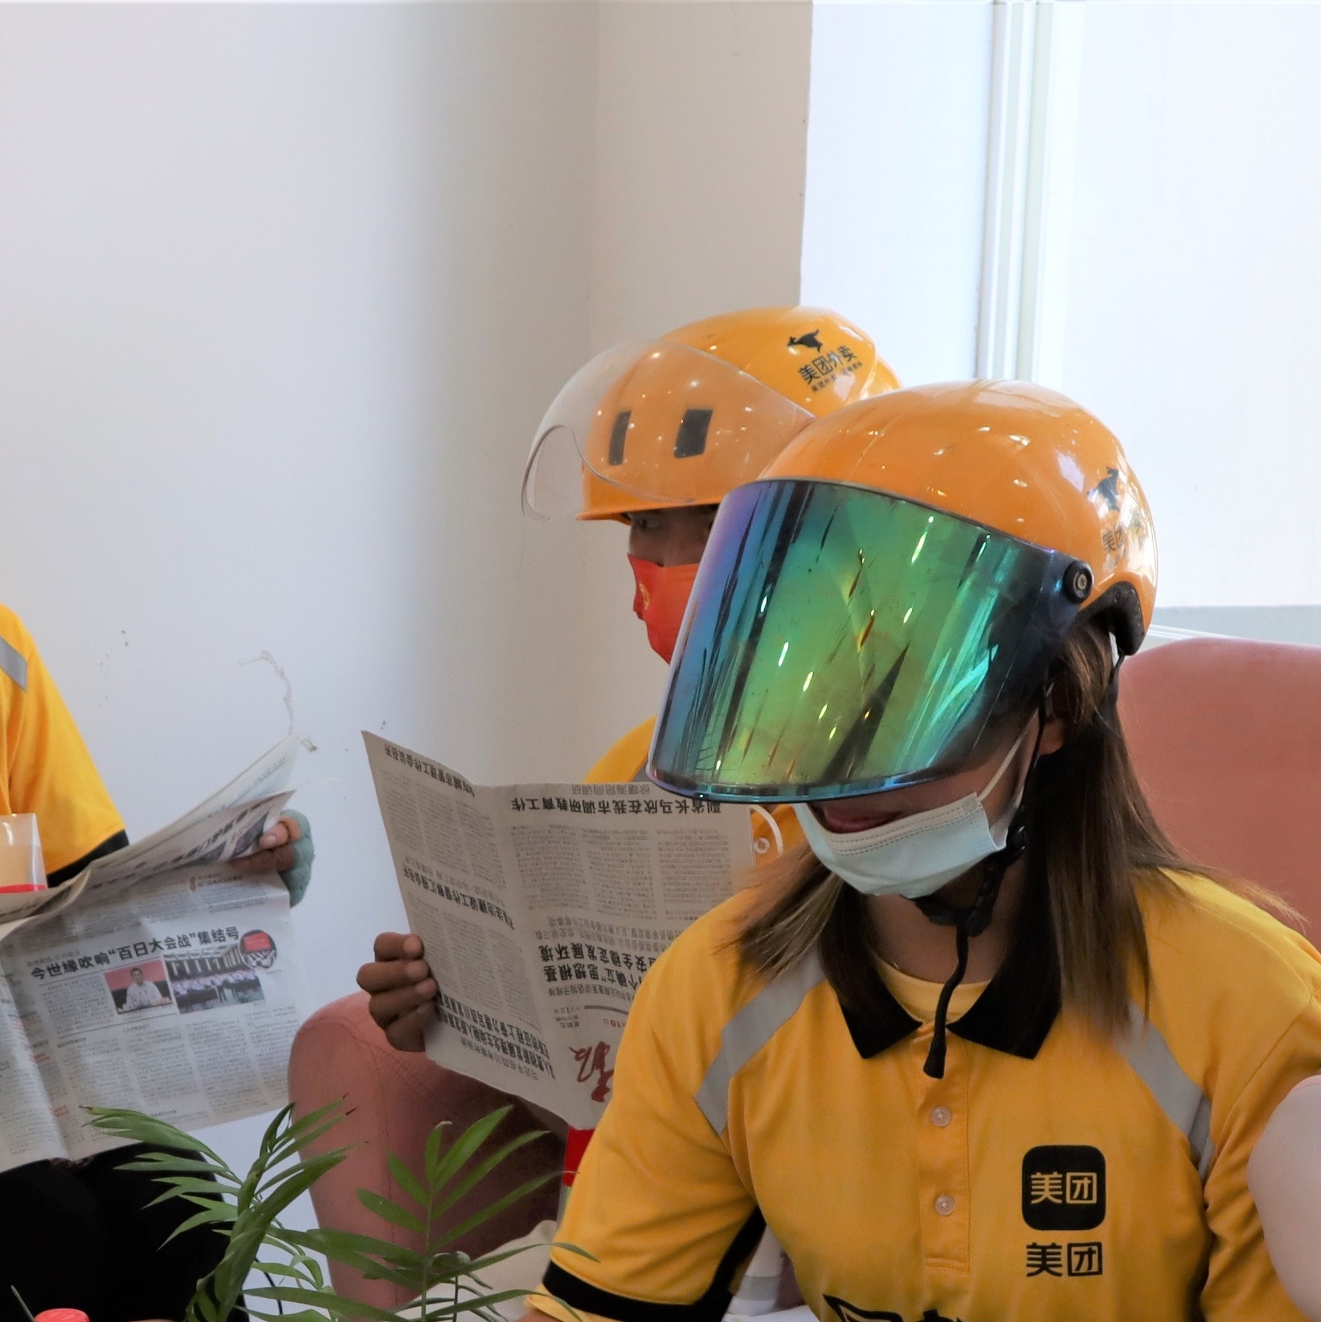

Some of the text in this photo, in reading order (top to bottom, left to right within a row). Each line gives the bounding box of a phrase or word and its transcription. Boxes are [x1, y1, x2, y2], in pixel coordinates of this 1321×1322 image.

[798, 345, 857, 386] 美团外卖
[511, 797, 722, 815] 副省长马欣在我市调研教育工作
[1030, 1171, 1097, 1205] 美团
[1026, 1241, 1102, 1278] 美团
